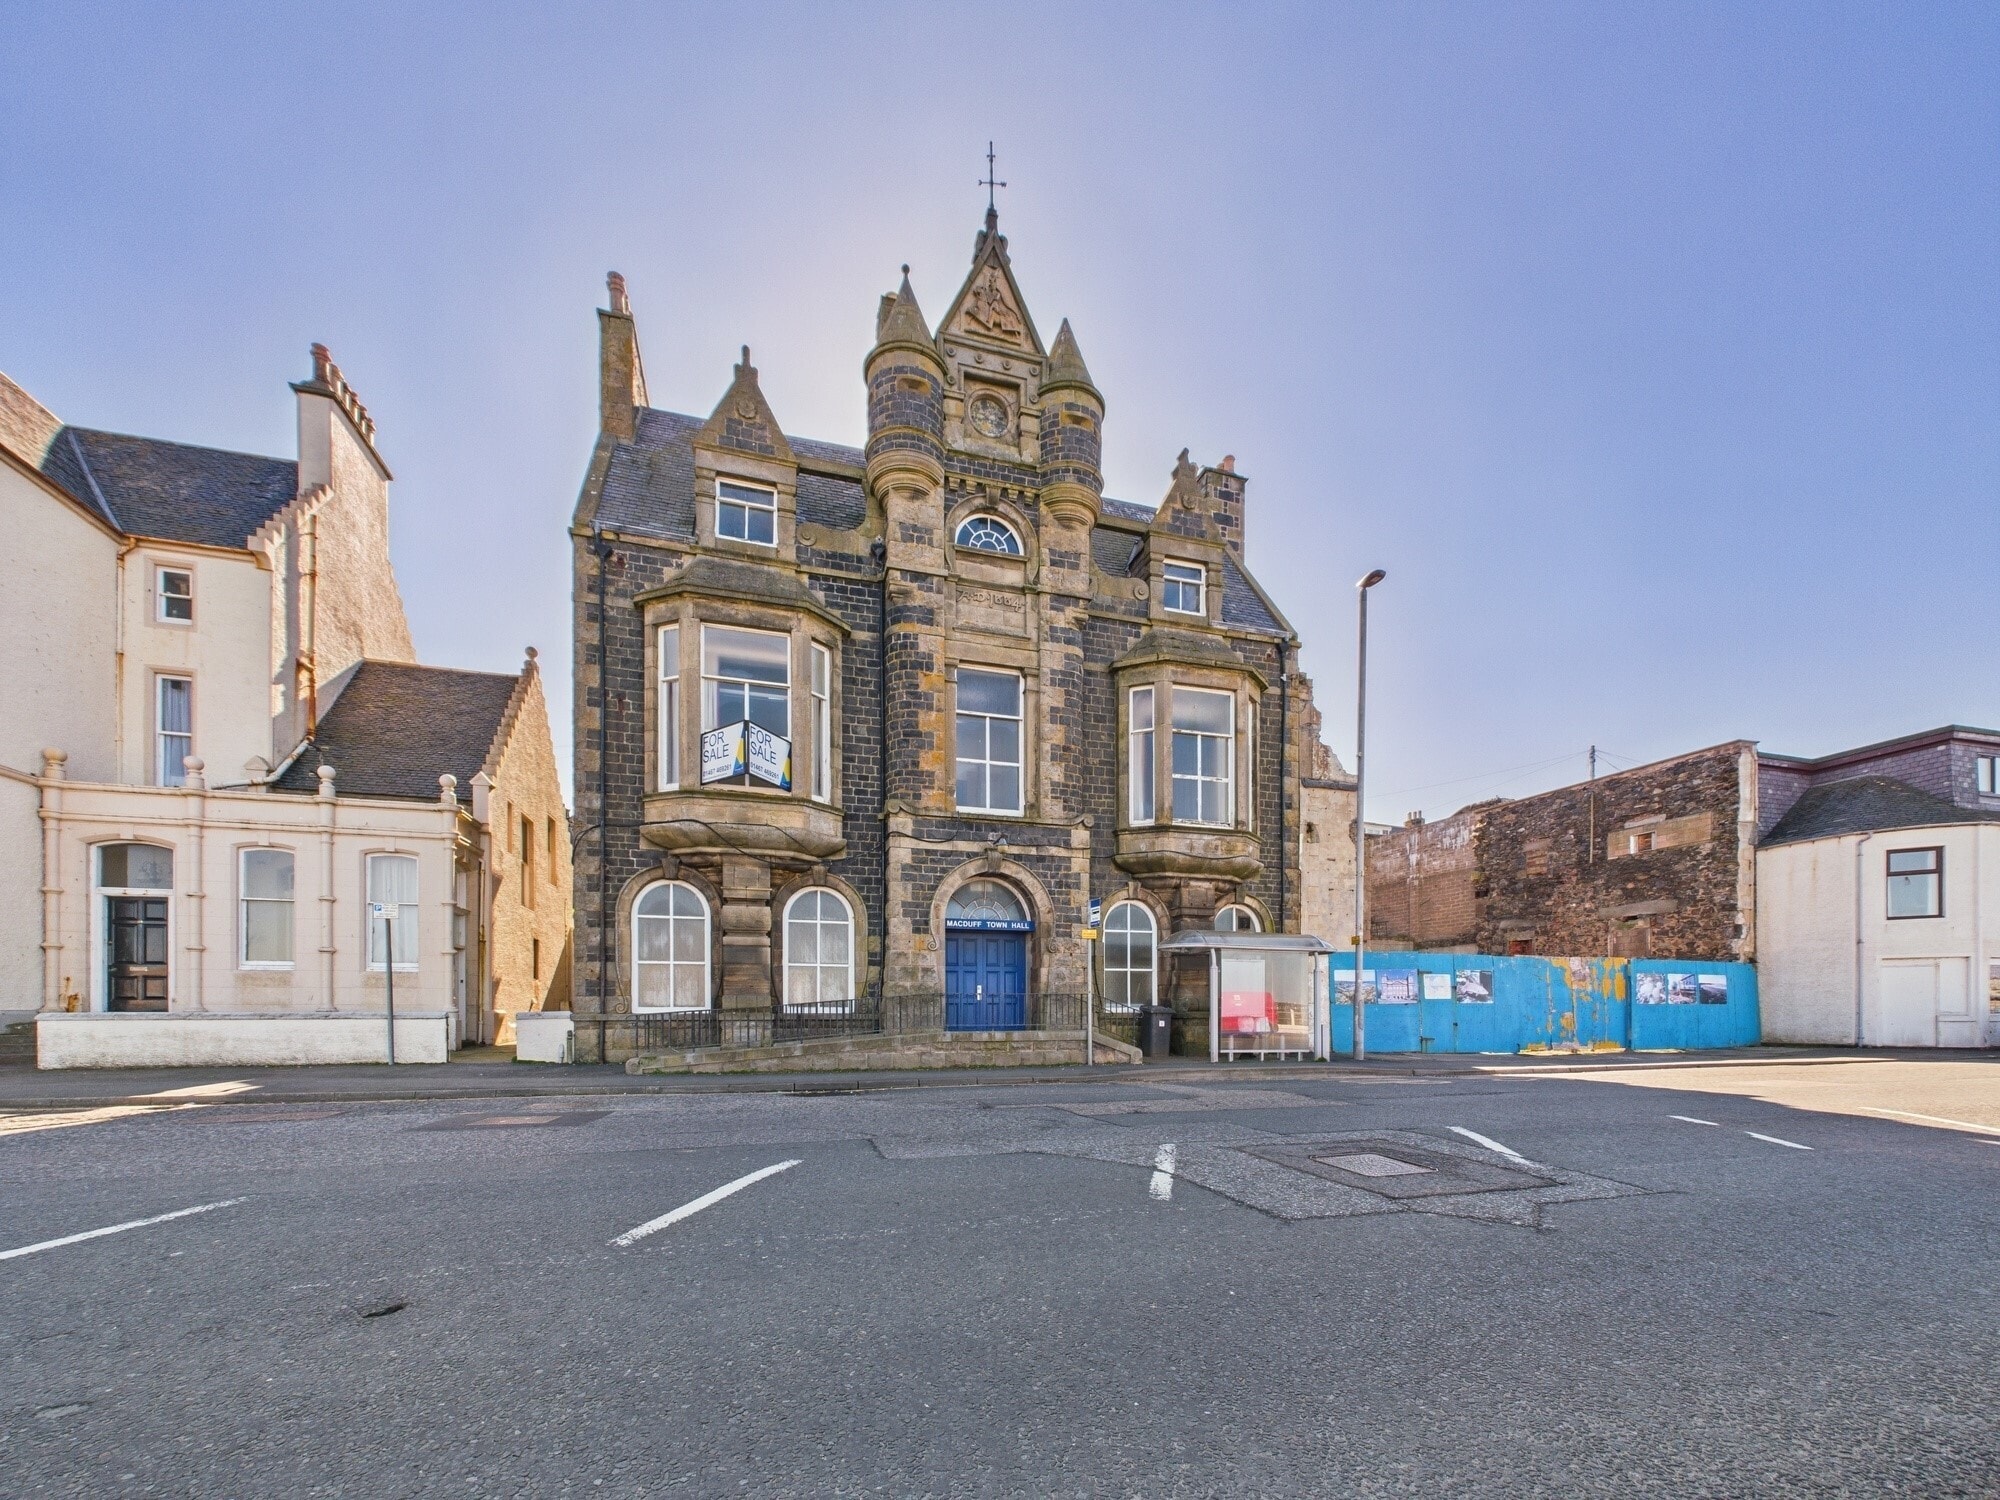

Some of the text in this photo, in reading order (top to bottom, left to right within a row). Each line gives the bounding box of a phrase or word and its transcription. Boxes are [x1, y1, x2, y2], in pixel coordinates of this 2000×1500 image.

[703, 731, 725, 749] FOR
[750, 726, 772, 748] FOR
[703, 743, 730, 763] SALE
[750, 742, 777, 765] SALE
